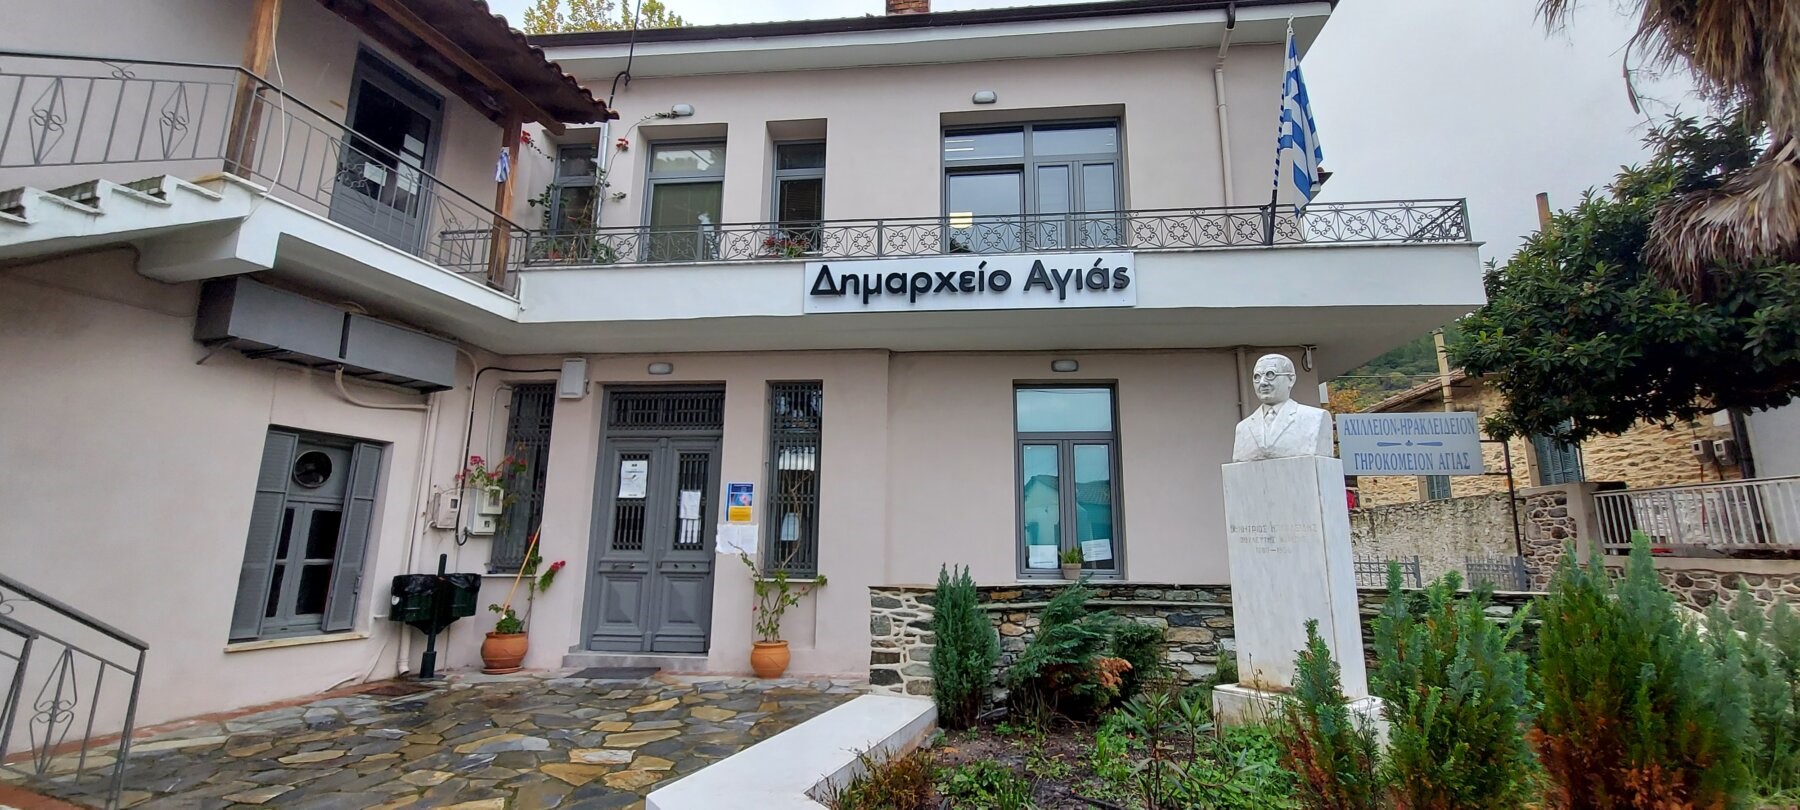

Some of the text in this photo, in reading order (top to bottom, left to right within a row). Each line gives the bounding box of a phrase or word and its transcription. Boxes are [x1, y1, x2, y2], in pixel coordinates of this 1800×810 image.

[810, 258, 1130, 304] Δημαρχείο Αγιάς
[1354, 452, 1471, 471] ΓΗΡΟΚΟΜΕΙΟΝ ΑΓΙΑΣ
